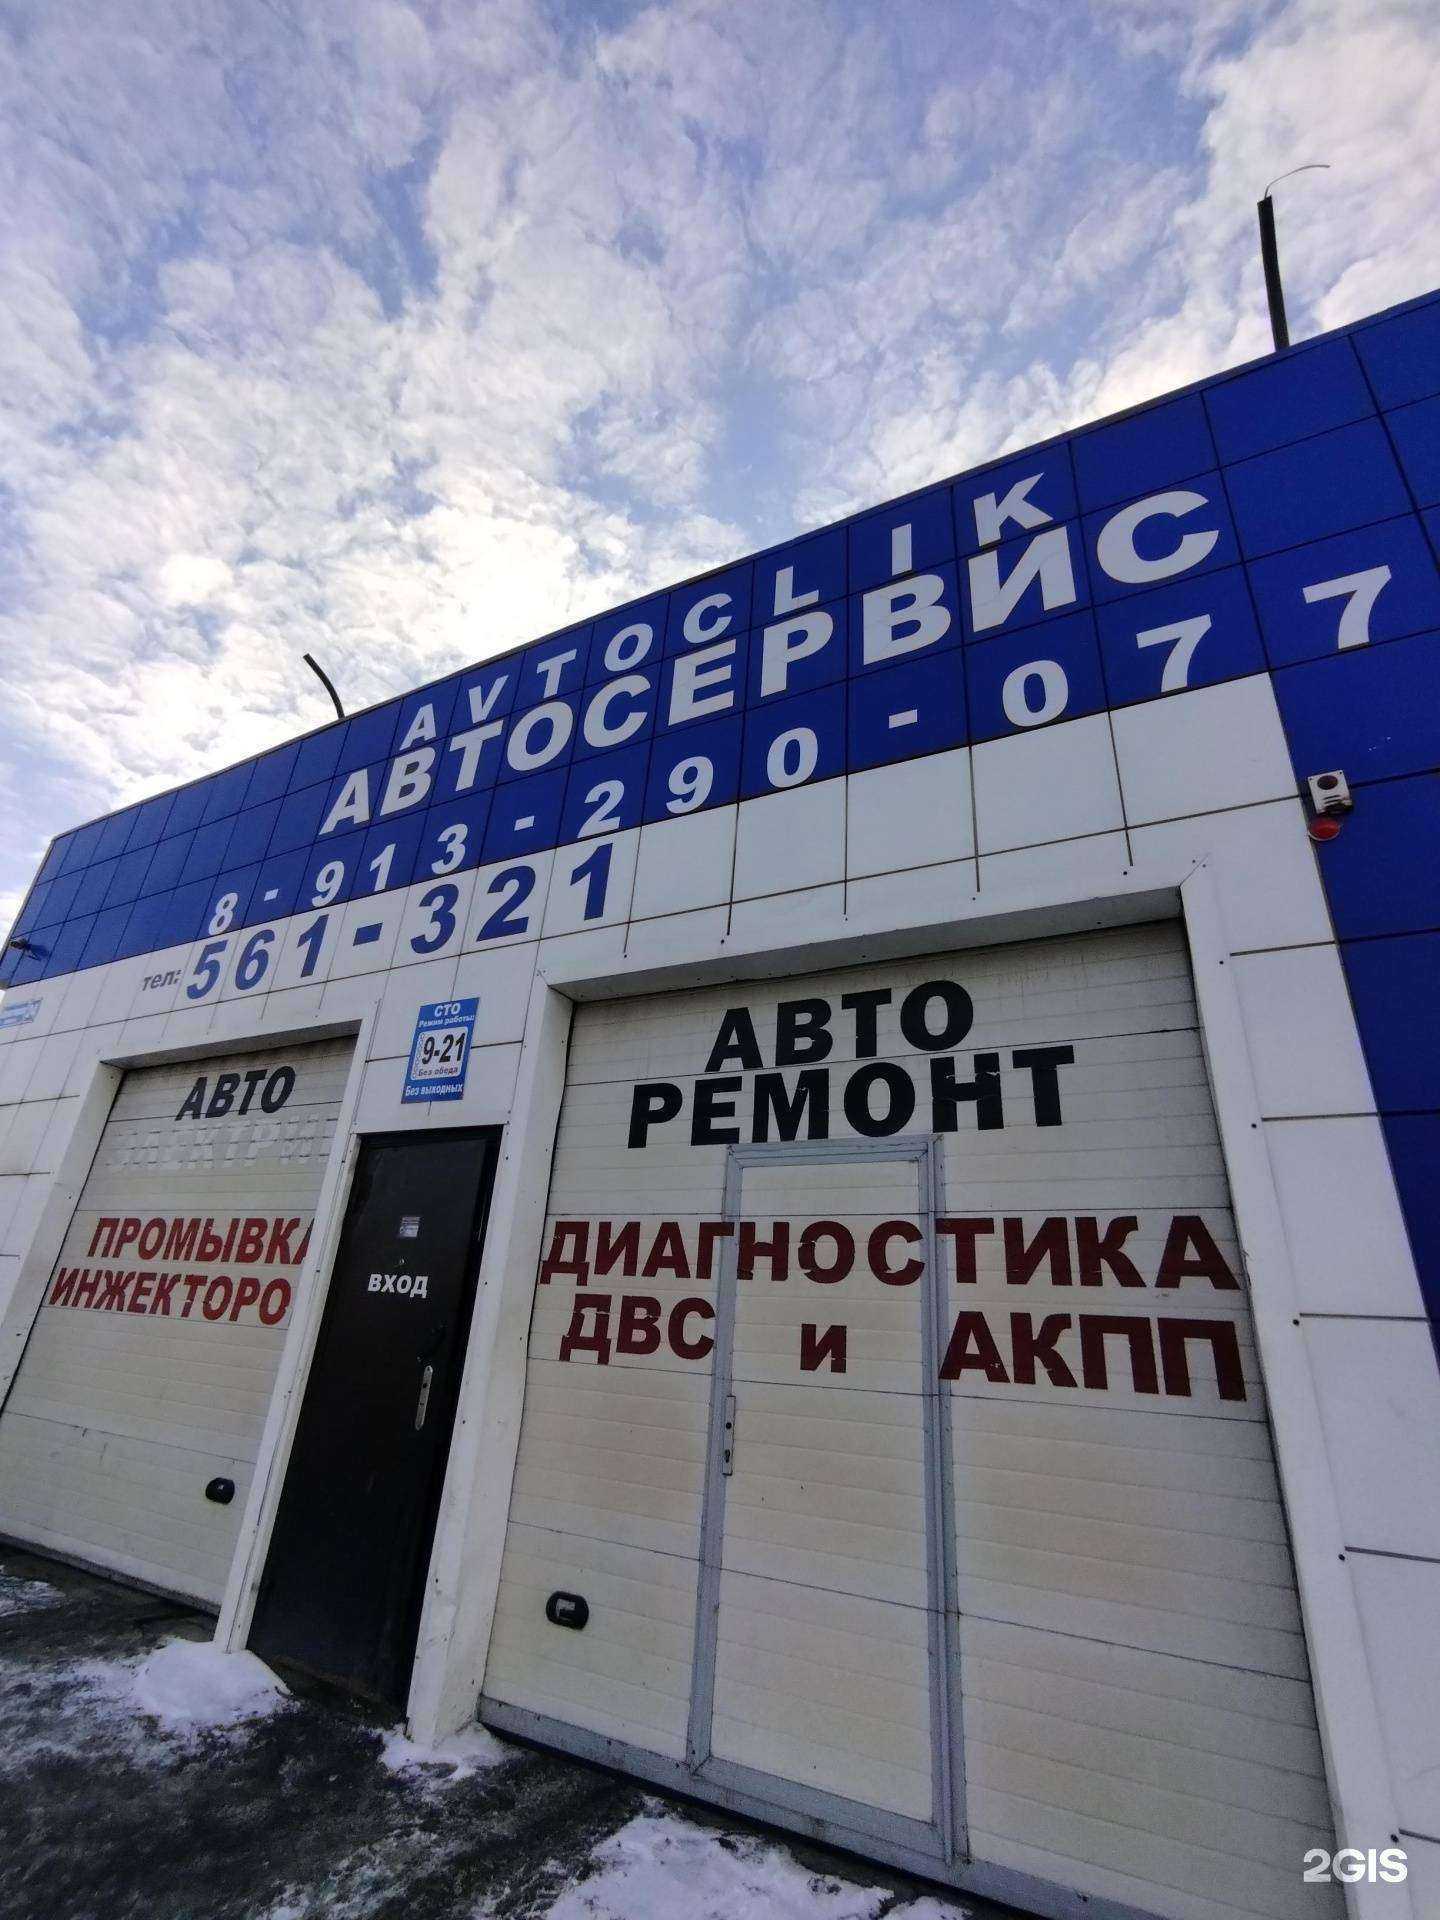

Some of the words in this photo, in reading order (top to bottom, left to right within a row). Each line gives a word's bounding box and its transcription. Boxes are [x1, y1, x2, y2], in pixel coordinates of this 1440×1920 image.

[318, 490, 1220, 836] АВТОСЕРВИС
[142, 969, 182, 991] тел:
[187, 843, 613, 1000] 561-321
[418, 1019, 443, 1028] Режим
[434, 1002, 461, 1018] СТО
[705, 980, 974, 1072] АВТО
[422, 1033, 466, 1065] 9-21
[175, 1066, 297, 1121] АВТО
[420, 1084, 463, 1095] выходных
[627, 1046, 1075, 1149] РЕМОНТ
[367, 1272, 429, 1299] ВХОД
[540, 1215, 1240, 1291] ДИАГНОСТИКА
[559, 1293, 717, 1365] ДВС
[939, 1310, 1247, 1401] АКПП
